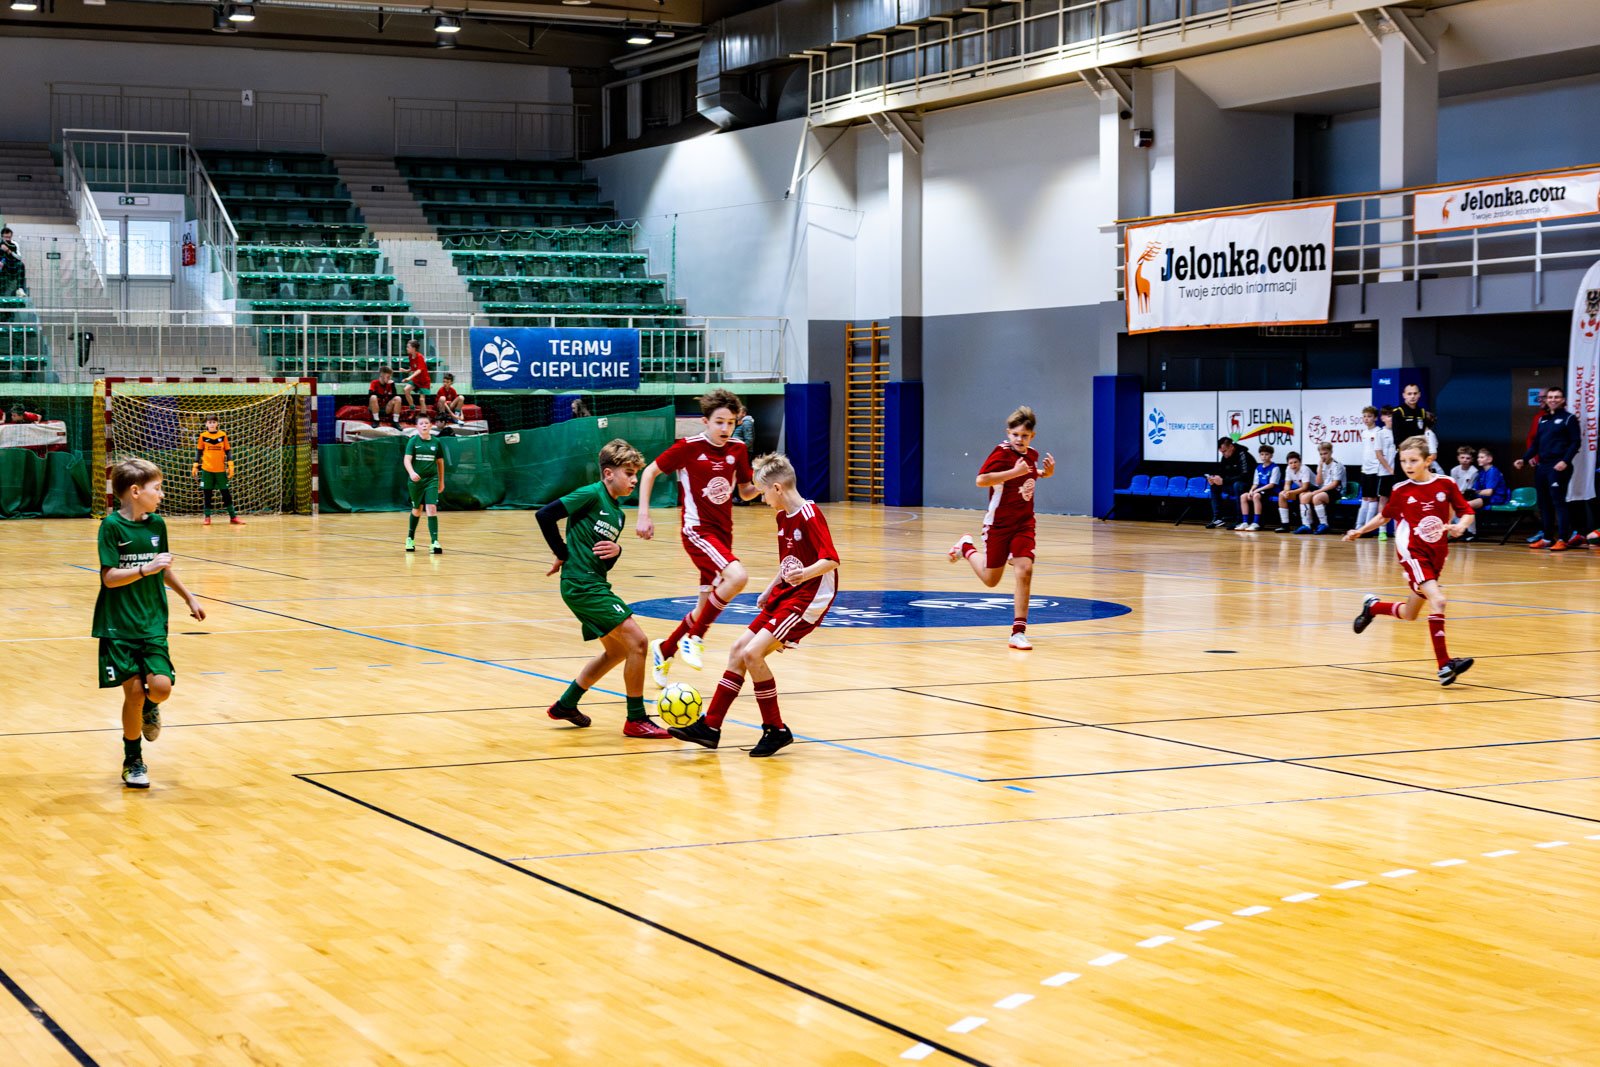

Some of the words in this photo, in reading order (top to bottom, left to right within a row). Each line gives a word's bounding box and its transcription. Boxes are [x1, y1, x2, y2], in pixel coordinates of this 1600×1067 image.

[244, 93, 250, 102] A
[1460, 186, 1566, 212] Jelonka.com
[1472, 212, 1492, 221] Twoje
[1161, 242, 1327, 282] Jelonka.com
[1178, 286, 1208, 300] Twoje
[1246, 278, 1298, 295] informacji
[549, 340, 612, 356] TERMY
[530, 362, 630, 377] CIEPLICKIE
[1247, 409, 1293, 426] JELENIA
[1330, 415, 1347, 425] Park
[1168, 423, 1186, 431] TERMY
[1258, 425, 1293, 446] GÓRA
[1330, 429, 1364, 443] ZŁOTN
[119, 553, 137, 561] AUTO
[612, 603, 626, 614] 4
[105, 666, 116, 681] 3
